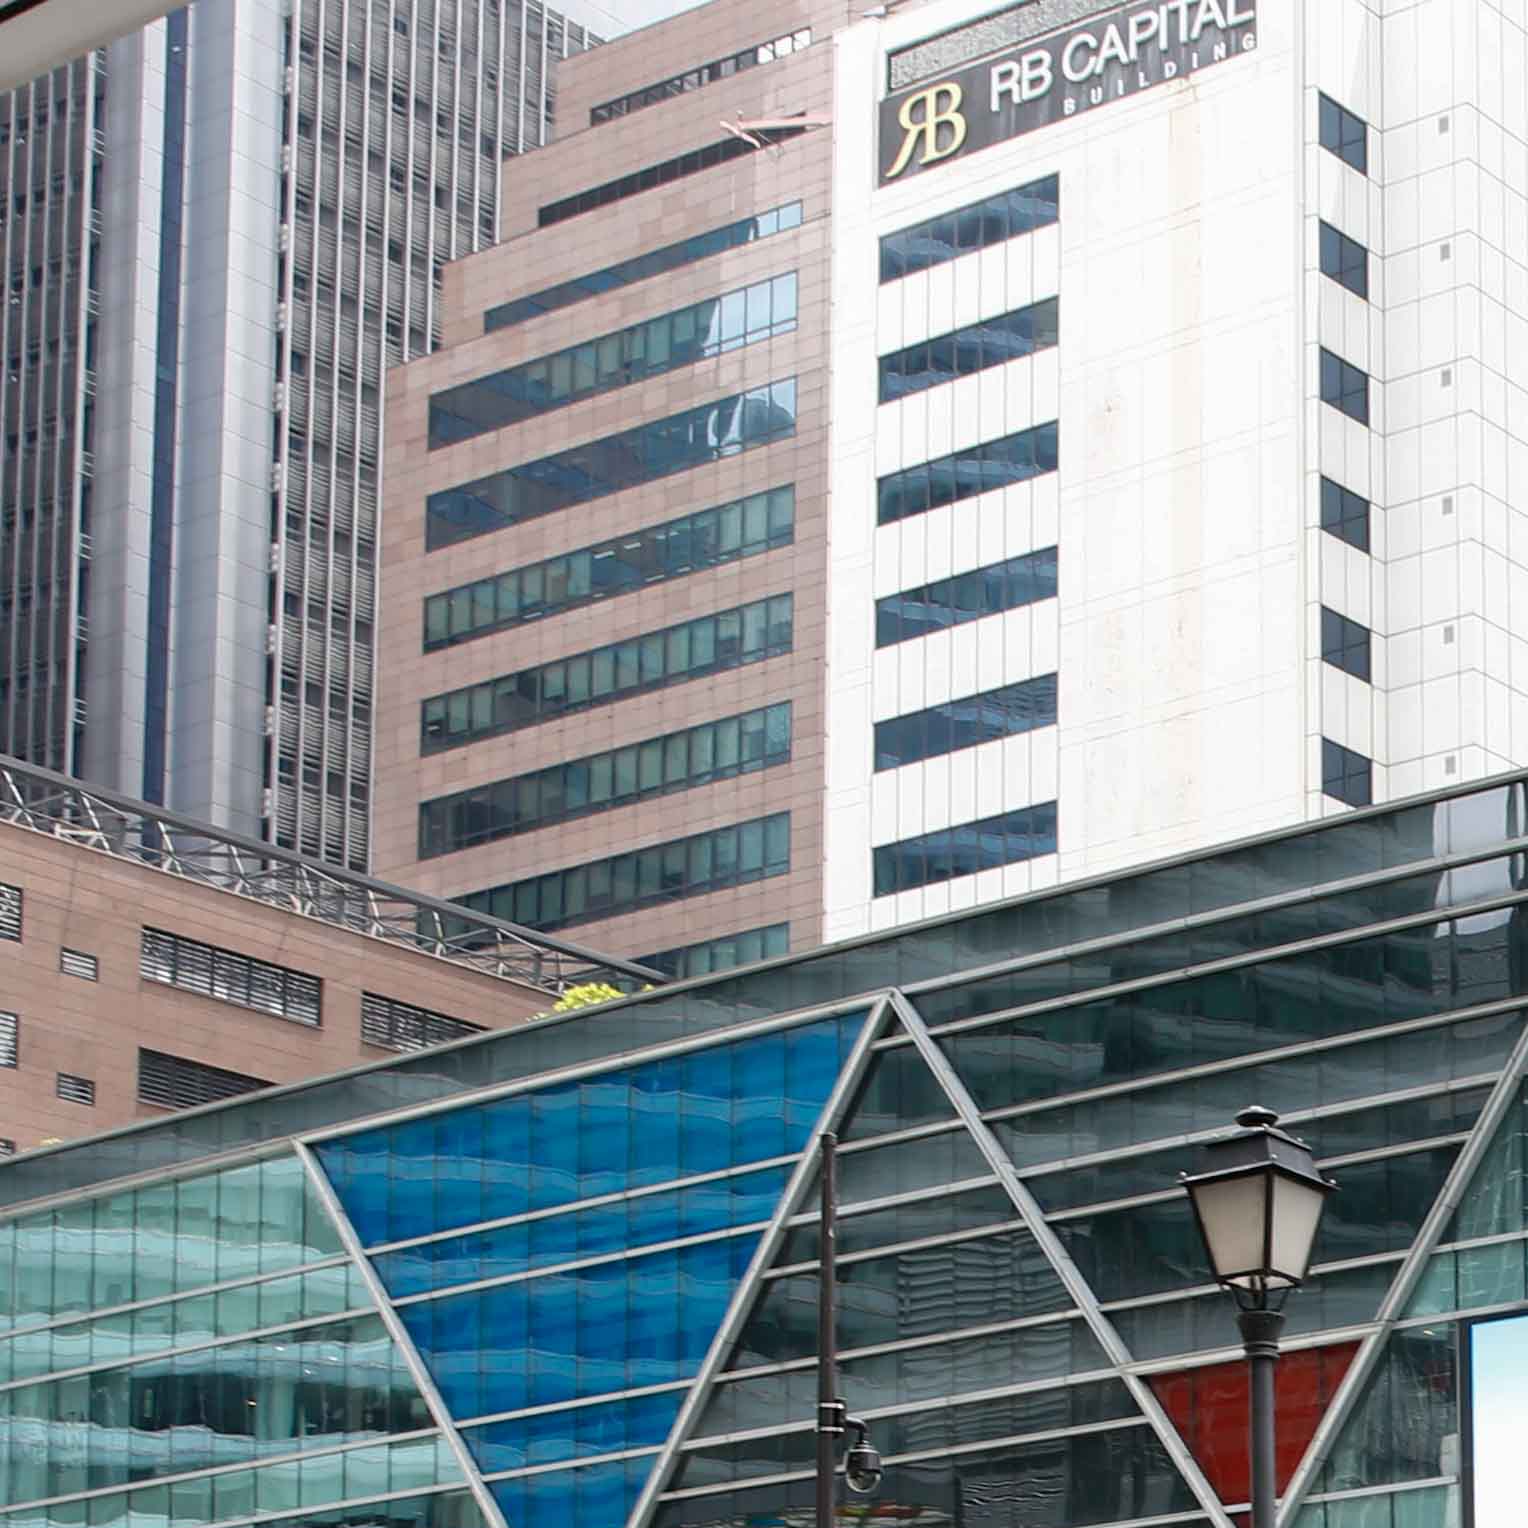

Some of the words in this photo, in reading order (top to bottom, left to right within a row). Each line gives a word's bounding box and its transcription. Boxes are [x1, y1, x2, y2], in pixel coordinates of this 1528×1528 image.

[990, 48, 1054, 112] RB
[1060, 0, 1254, 83] CAPITAL
[1063, 33, 1256, 116] BUILDING
